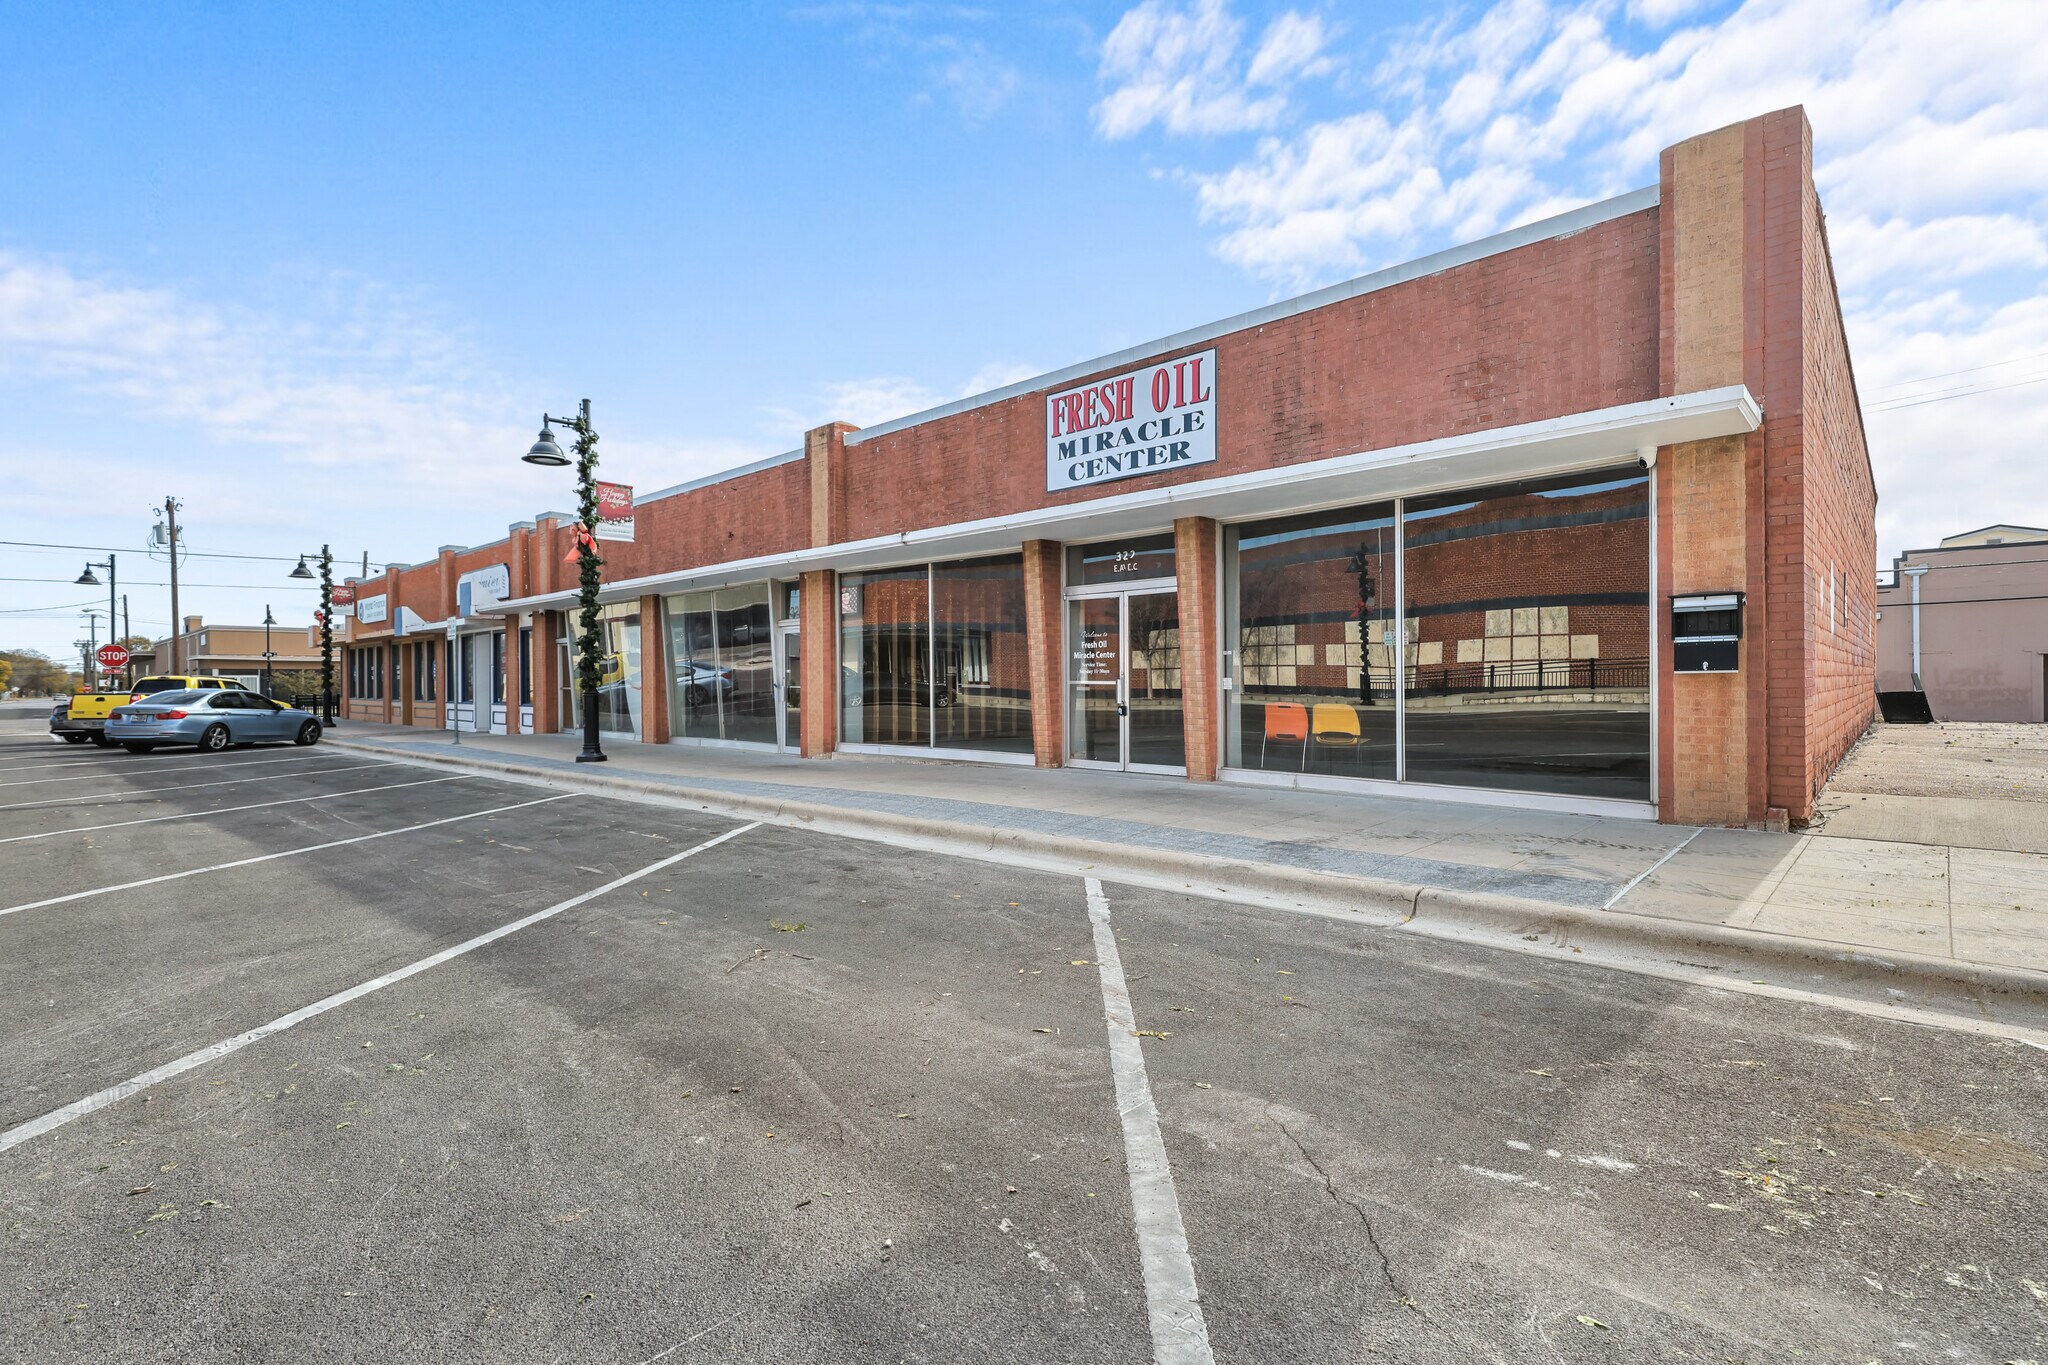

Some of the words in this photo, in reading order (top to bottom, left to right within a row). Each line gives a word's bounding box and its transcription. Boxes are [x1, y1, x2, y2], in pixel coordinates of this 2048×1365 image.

[1052, 377, 1135, 438] FRESH
[1152, 357, 1210, 412] OIL
[1058, 410, 1205, 461] MIRACLE
[1068, 440, 1191, 481] CENTER
[99, 651, 127, 661] STOP
[1073, 651, 1095, 659] Miracle
[1081, 640, 1098, 648] Fresh
[1098, 640, 1107, 648] Oil
